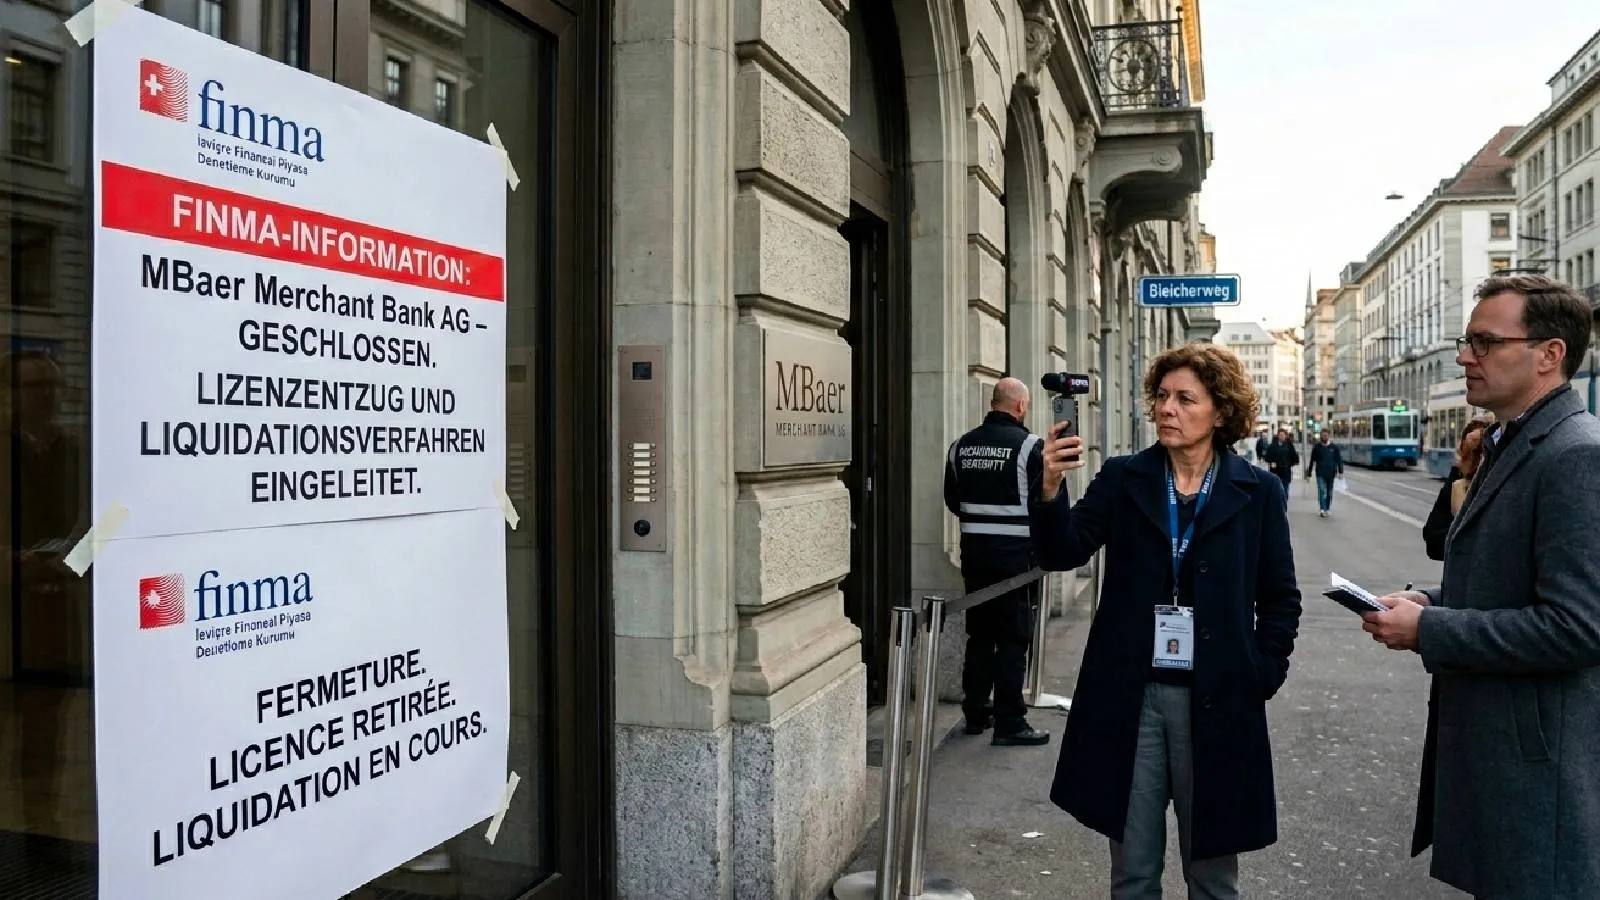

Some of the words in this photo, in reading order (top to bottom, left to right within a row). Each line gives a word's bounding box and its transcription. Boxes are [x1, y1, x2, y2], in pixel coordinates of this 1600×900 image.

[197, 79, 325, 163] finma
[173, 193, 471, 286] FINMA-INFORMATION:
[141, 254, 246, 302] MBaer
[255, 273, 374, 322] Merchant
[382, 298, 435, 329] Bank
[440, 306, 470, 334] AG
[1149, 283, 1230, 301] Bleicherweg
[238, 319, 437, 369] GESCHLOSSEN.
[197, 371, 405, 413] LIZENZENTZUG
[411, 387, 456, 416] UND
[776, 361, 846, 414] MBaer
[140, 421, 485, 458] LIQUIDATIONSVERFAHREN
[251, 467, 422, 503] EINGELEITET.
[194, 570, 314, 622] finma
[256, 648, 428, 724] FERMETURE.
[209, 717, 345, 791] LICENCE
[353, 678, 457, 742] RETIRÉE.
[153, 757, 361, 867] LIQUIDATION
[369, 740, 401, 780] EN
[408, 710, 488, 763] COURS.
